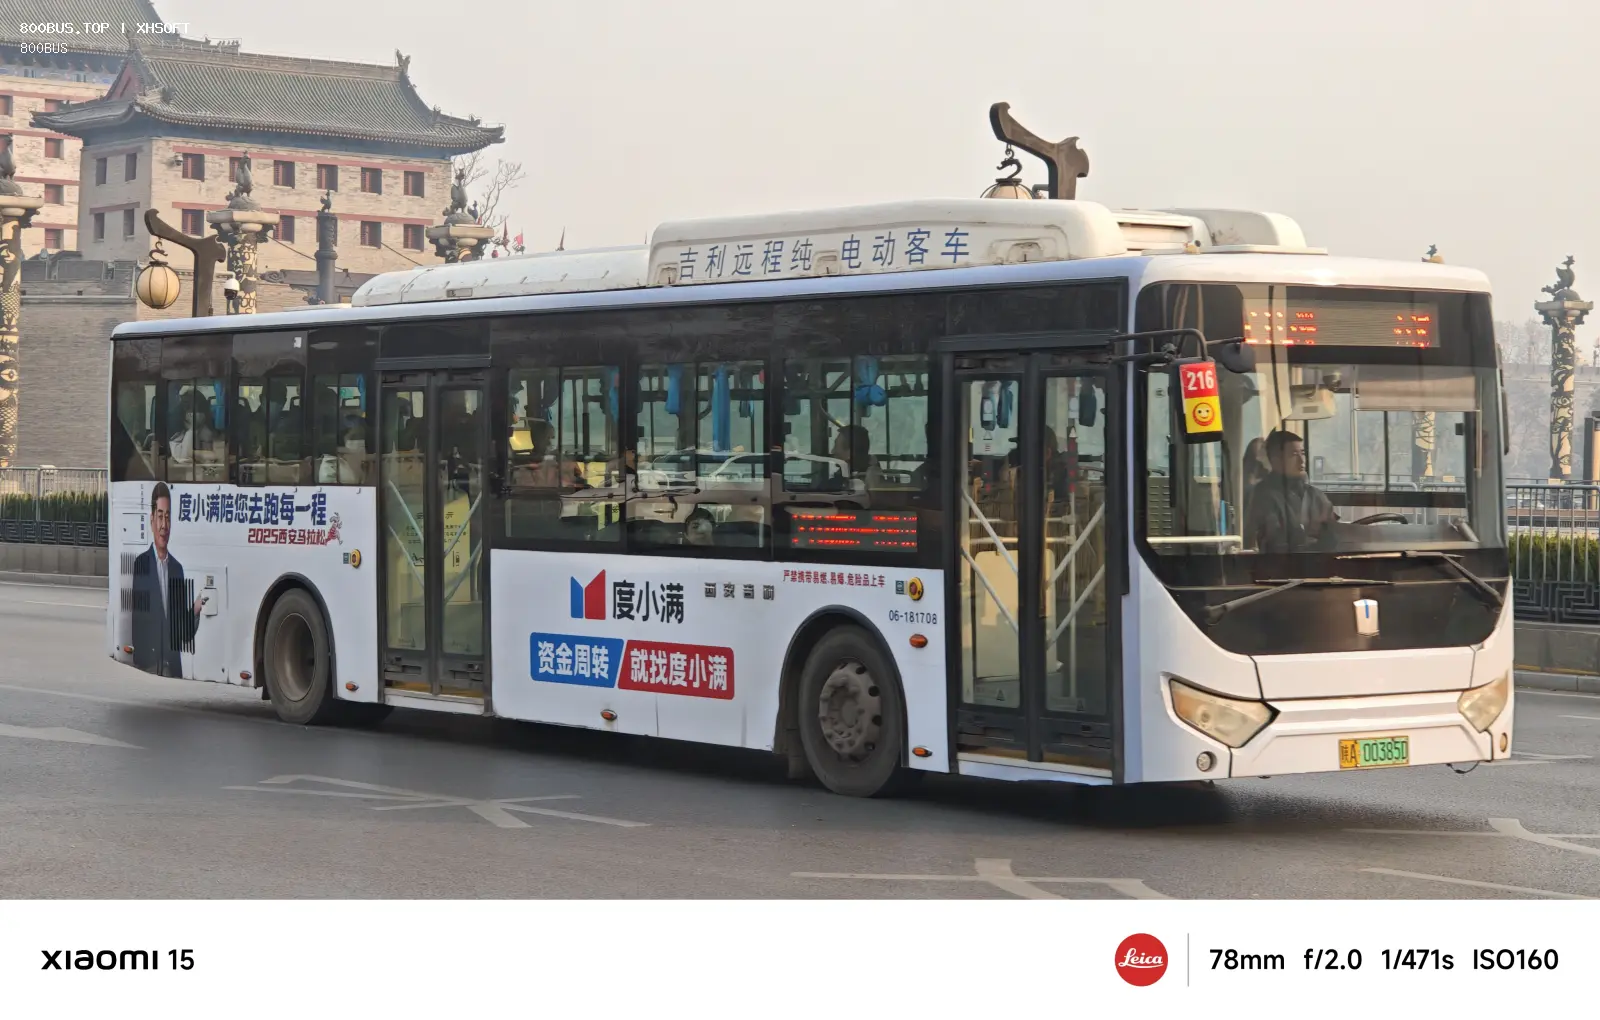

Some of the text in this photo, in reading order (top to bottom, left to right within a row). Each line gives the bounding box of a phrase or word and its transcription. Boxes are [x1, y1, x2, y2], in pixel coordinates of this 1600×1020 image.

[1186, 370, 1214, 391] 216
[178, 492, 327, 526] 度小满陪您去跑每一程
[247, 528, 326, 546] 2025西安马拉松
[612, 579, 685, 624] 度小满
[888, 609, 938, 625] 06-181708
[537, 640, 610, 680] 资金周转
[629, 647, 728, 691] 就找度小满
